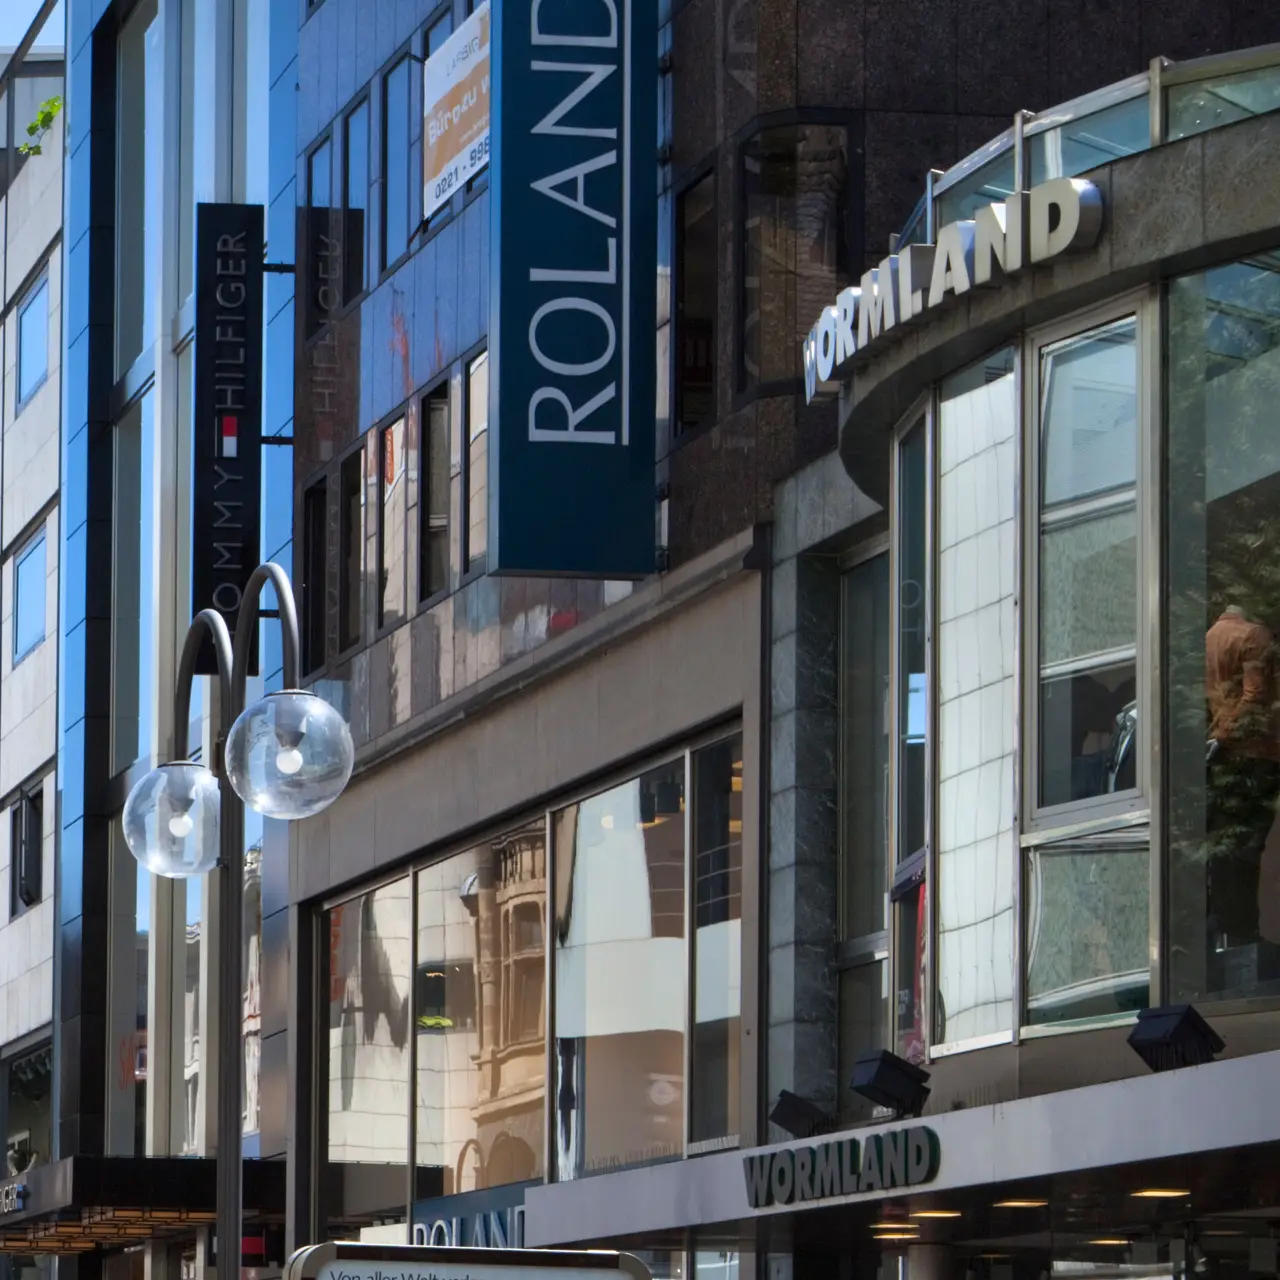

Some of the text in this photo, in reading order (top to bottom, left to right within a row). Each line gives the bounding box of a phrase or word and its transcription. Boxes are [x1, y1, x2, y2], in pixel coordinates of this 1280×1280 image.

[435, 165, 459, 200] 0221
[214, 230, 247, 411] HILFIGER
[802, 177, 1104, 406] WORMLAND
[212, 464, 244, 645] OMMY
[742, 1125, 941, 1209] WORMLAND
